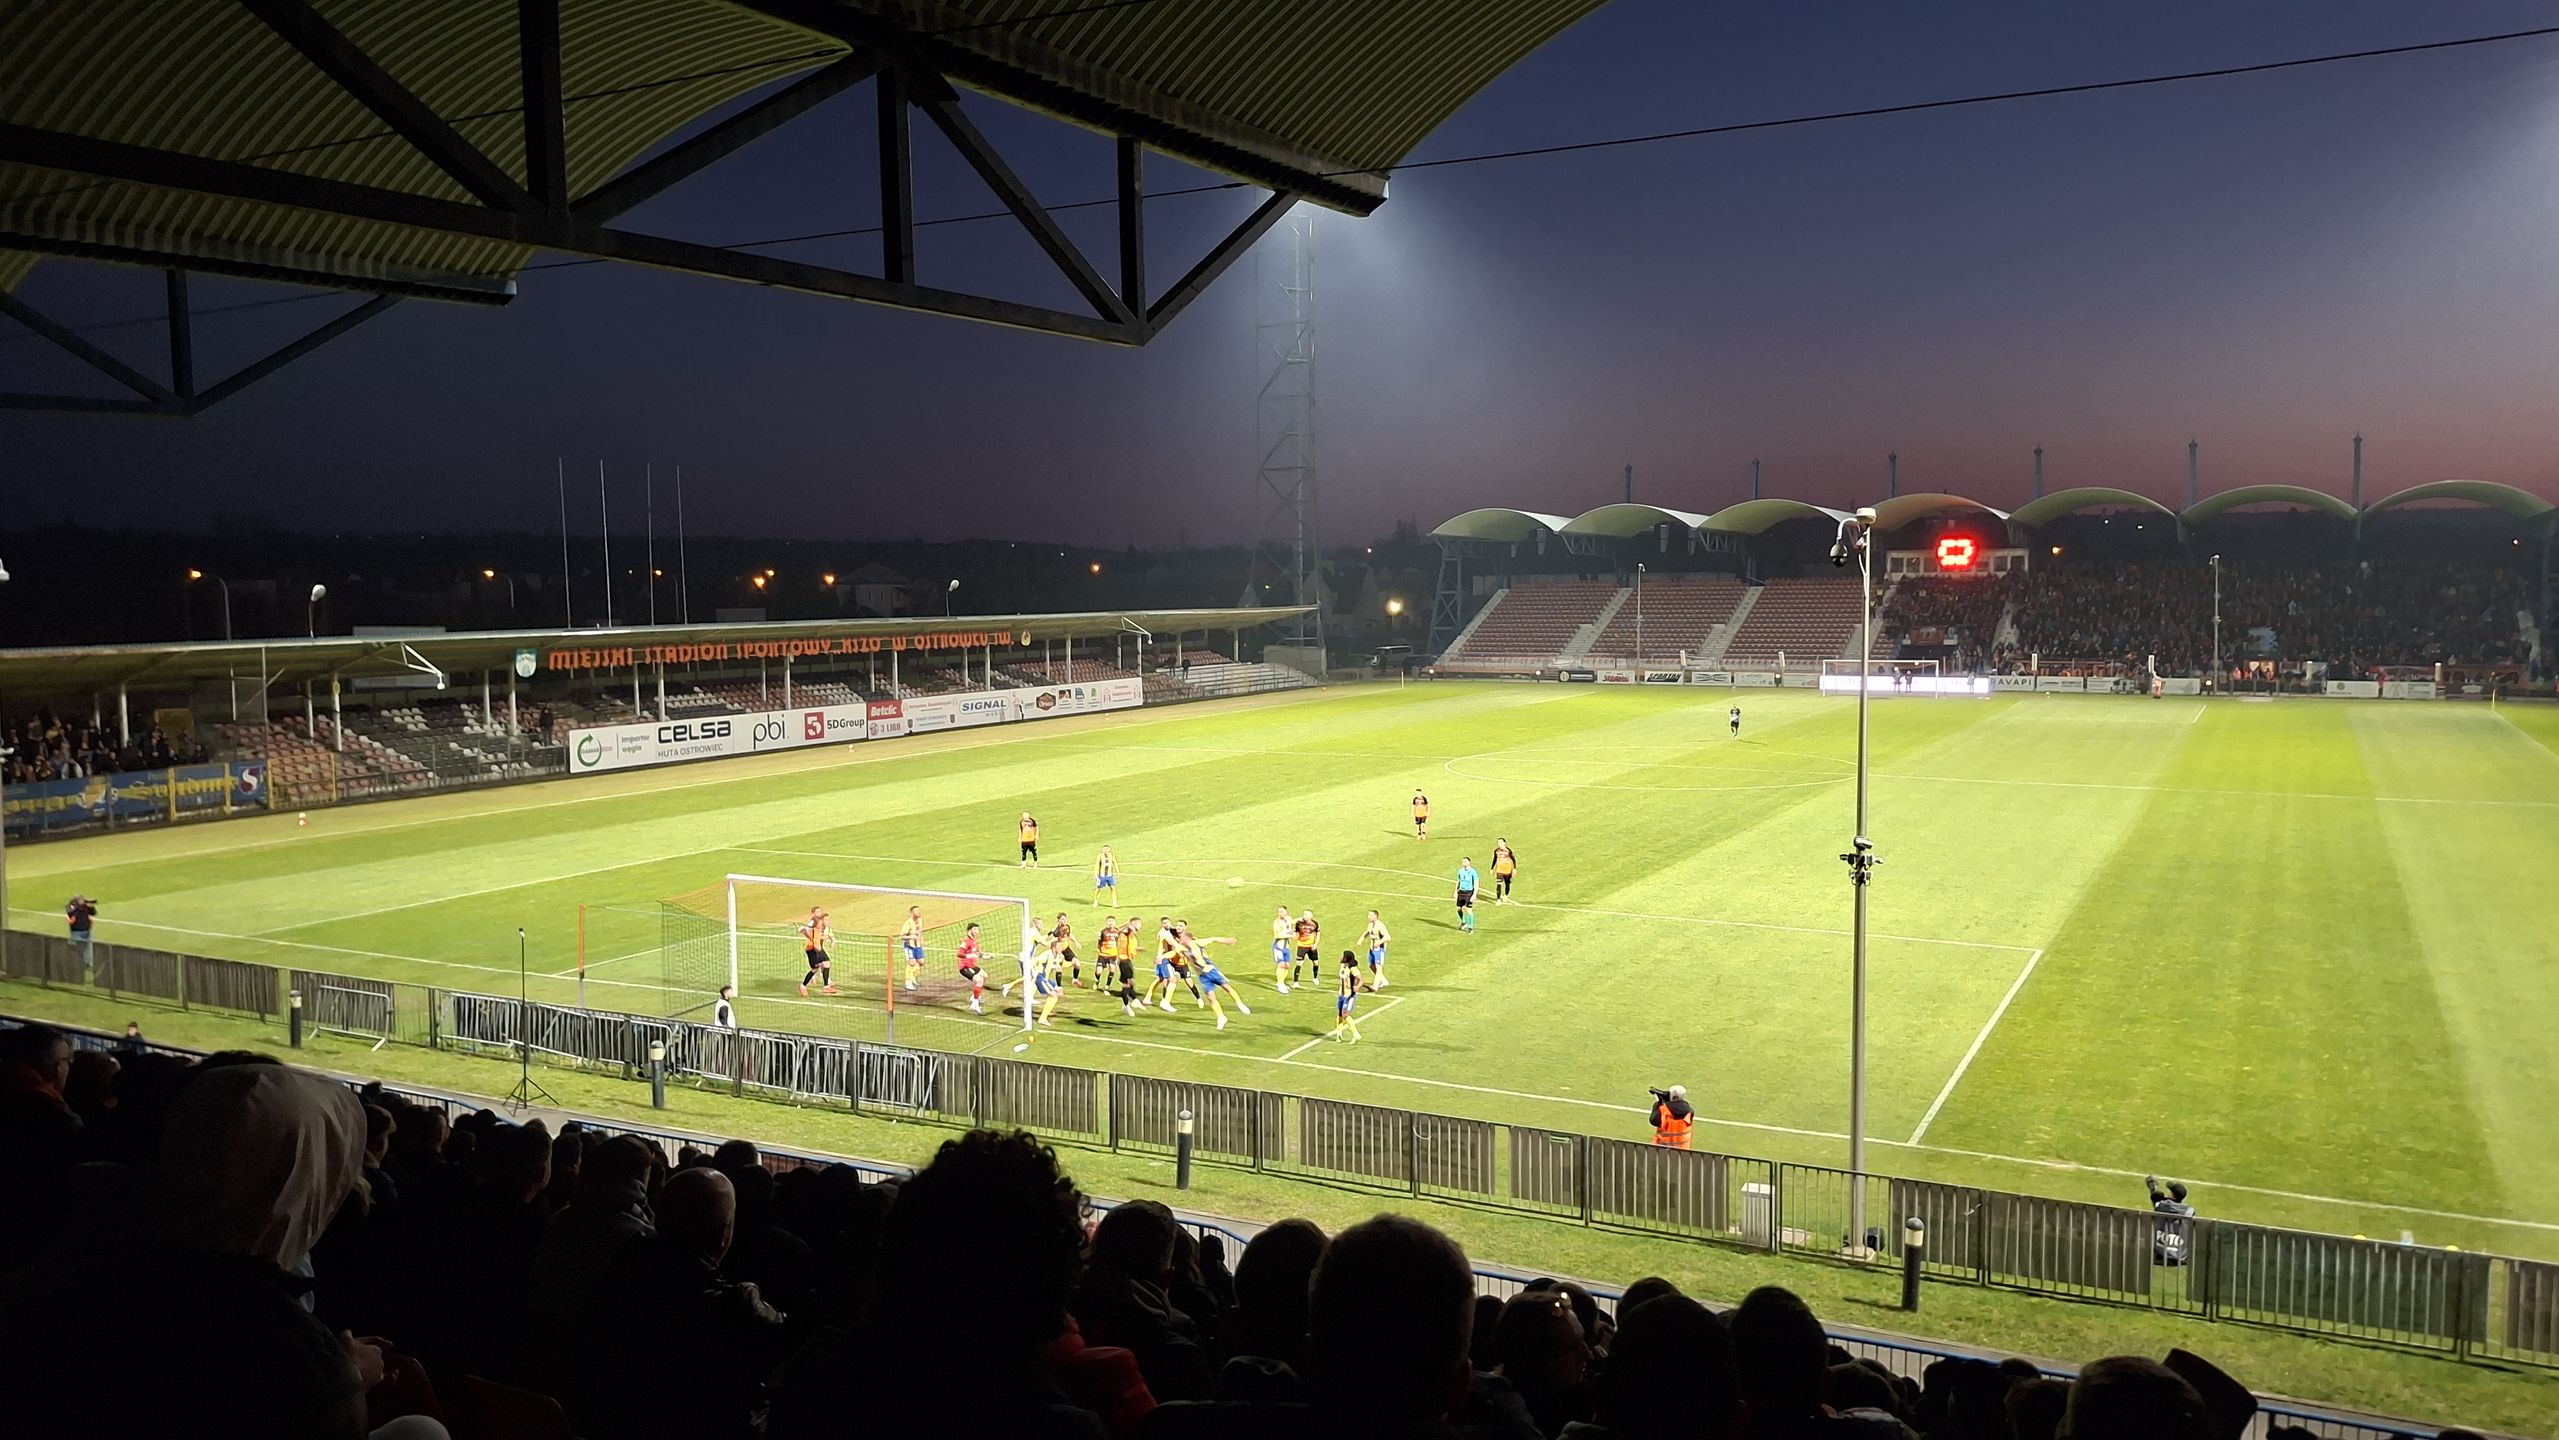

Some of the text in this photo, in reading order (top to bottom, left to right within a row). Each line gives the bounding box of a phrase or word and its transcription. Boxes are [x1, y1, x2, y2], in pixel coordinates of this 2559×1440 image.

[549, 648, 633, 669] MIEJSKI
[644, 643, 728, 664] STADION
[736, 639, 831, 658] SPORTOWY
[892, 636, 907, 651] W
[871, 703, 898, 717] Betclic
[962, 699, 1007, 712] SIGNAL
[753, 713, 785, 750] pbi
[657, 743, 724, 758] HUTA OSTROWIEC
